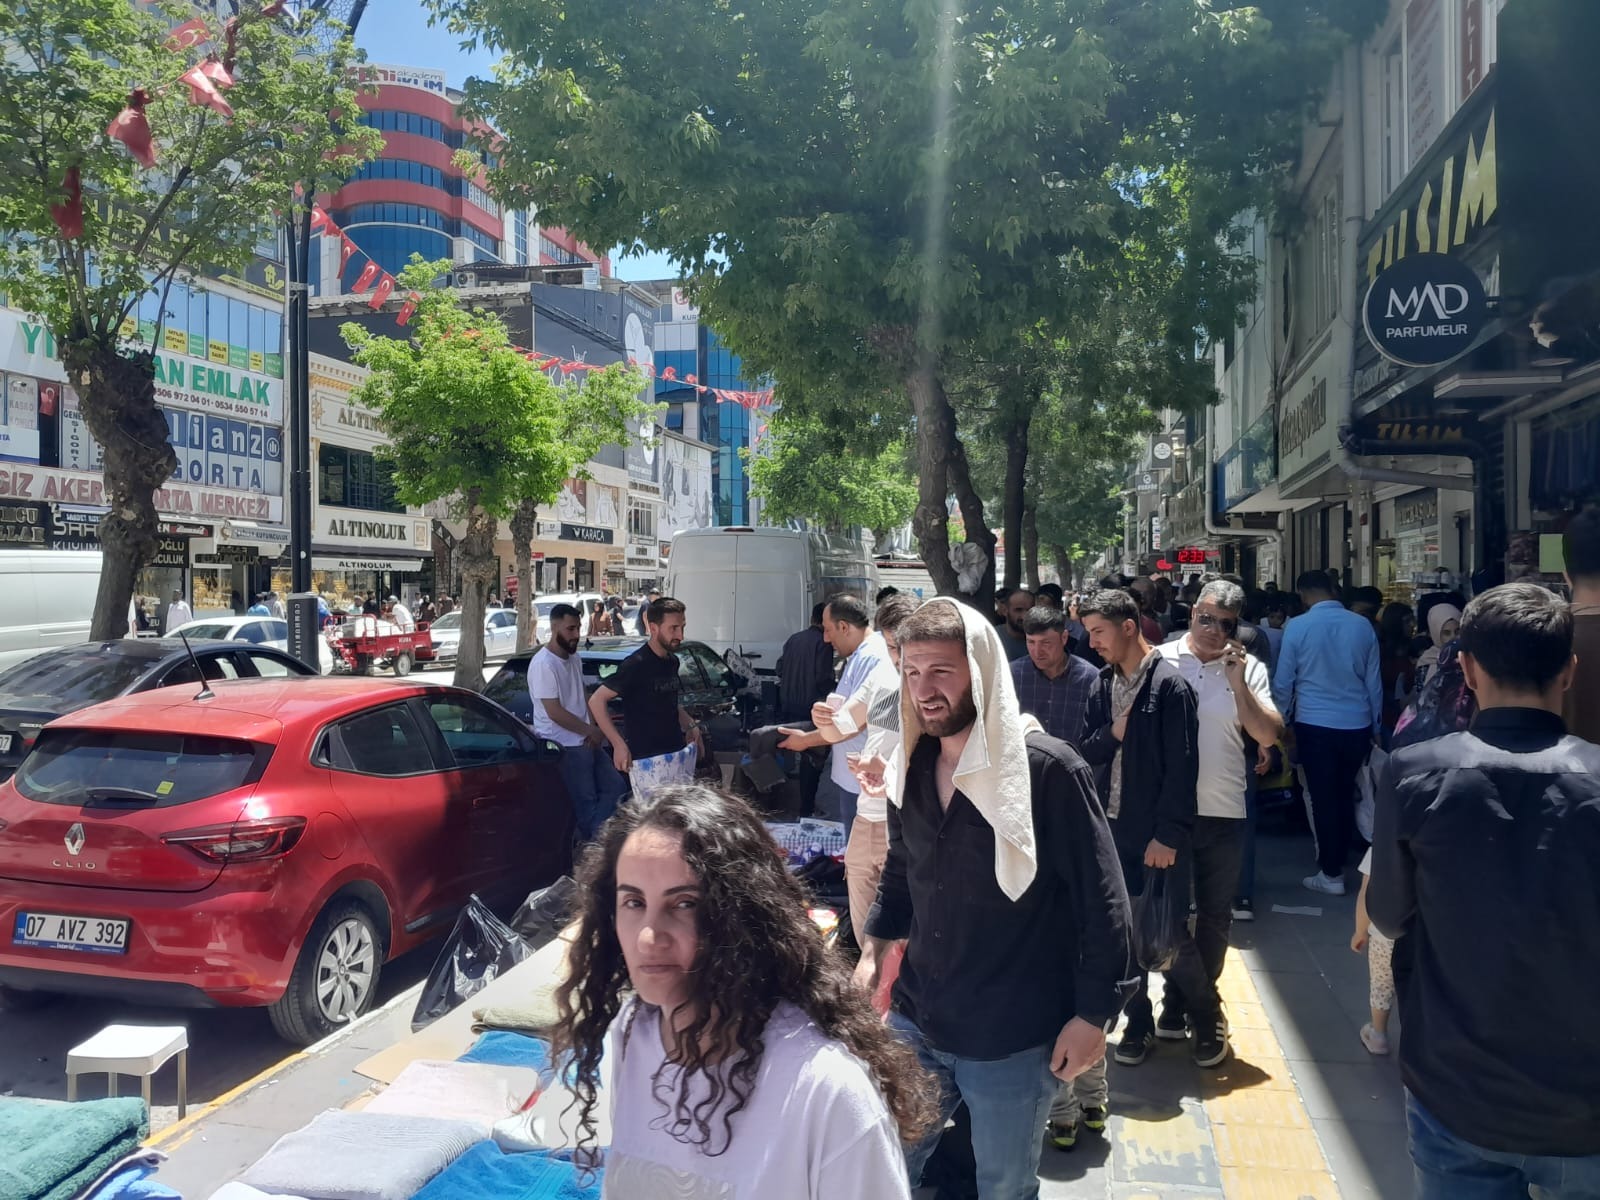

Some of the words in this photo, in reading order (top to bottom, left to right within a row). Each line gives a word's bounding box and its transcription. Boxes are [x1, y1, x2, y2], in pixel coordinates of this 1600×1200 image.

[1384, 281, 1469, 322] MAD
[1386, 324, 1468, 339] PARFUMEUR
[173, 391, 189, 402] 972
[192, 364, 270, 406] EMLAK
[171, 412, 262, 456] lianz
[171, 457, 262, 489] GORTA
[328, 519, 407, 541] ALTINOLUK
[338, 560, 393, 569] ALTINOLUK
[52, 859, 97, 870] CLIO
[25, 915, 46, 938] 07
[56, 918, 88, 942] AVZ
[94, 921, 126, 945] 392
